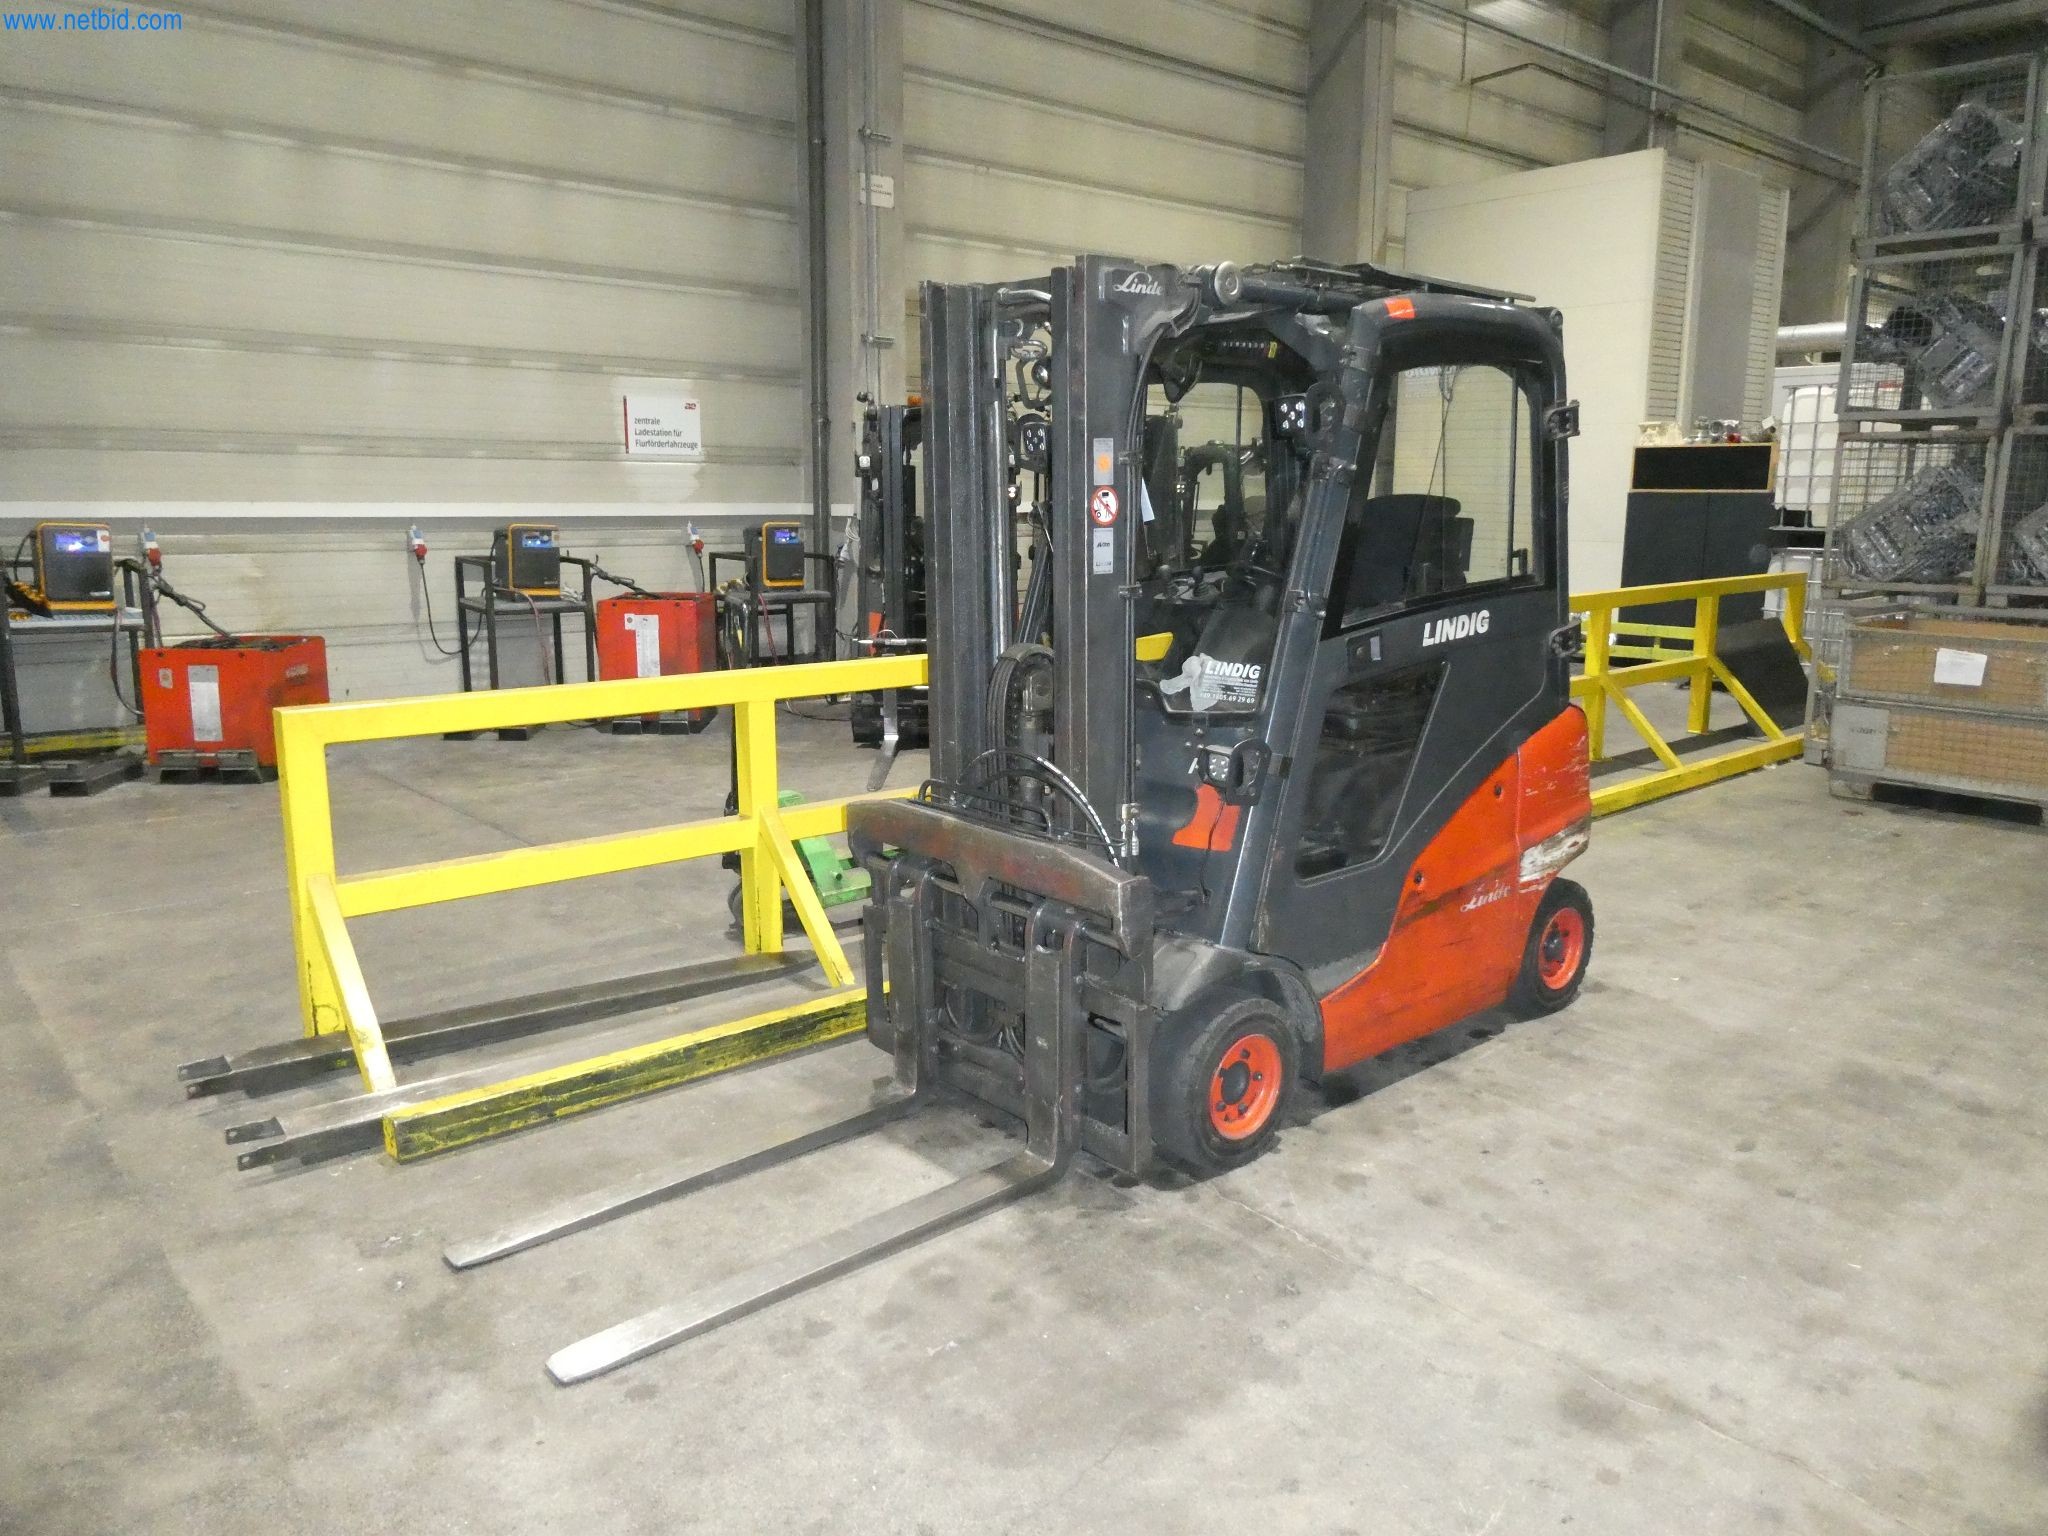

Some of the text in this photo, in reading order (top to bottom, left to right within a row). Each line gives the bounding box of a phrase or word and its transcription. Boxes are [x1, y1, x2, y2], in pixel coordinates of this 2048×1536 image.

[634, 417, 661, 425] zentrale
[634, 428, 673, 437] Ladestation
[635, 439, 699, 451] Flurförderfahrzeuge
[1422, 609, 1490, 647] LINDIG
[1205, 661, 1261, 679] LINDIG
